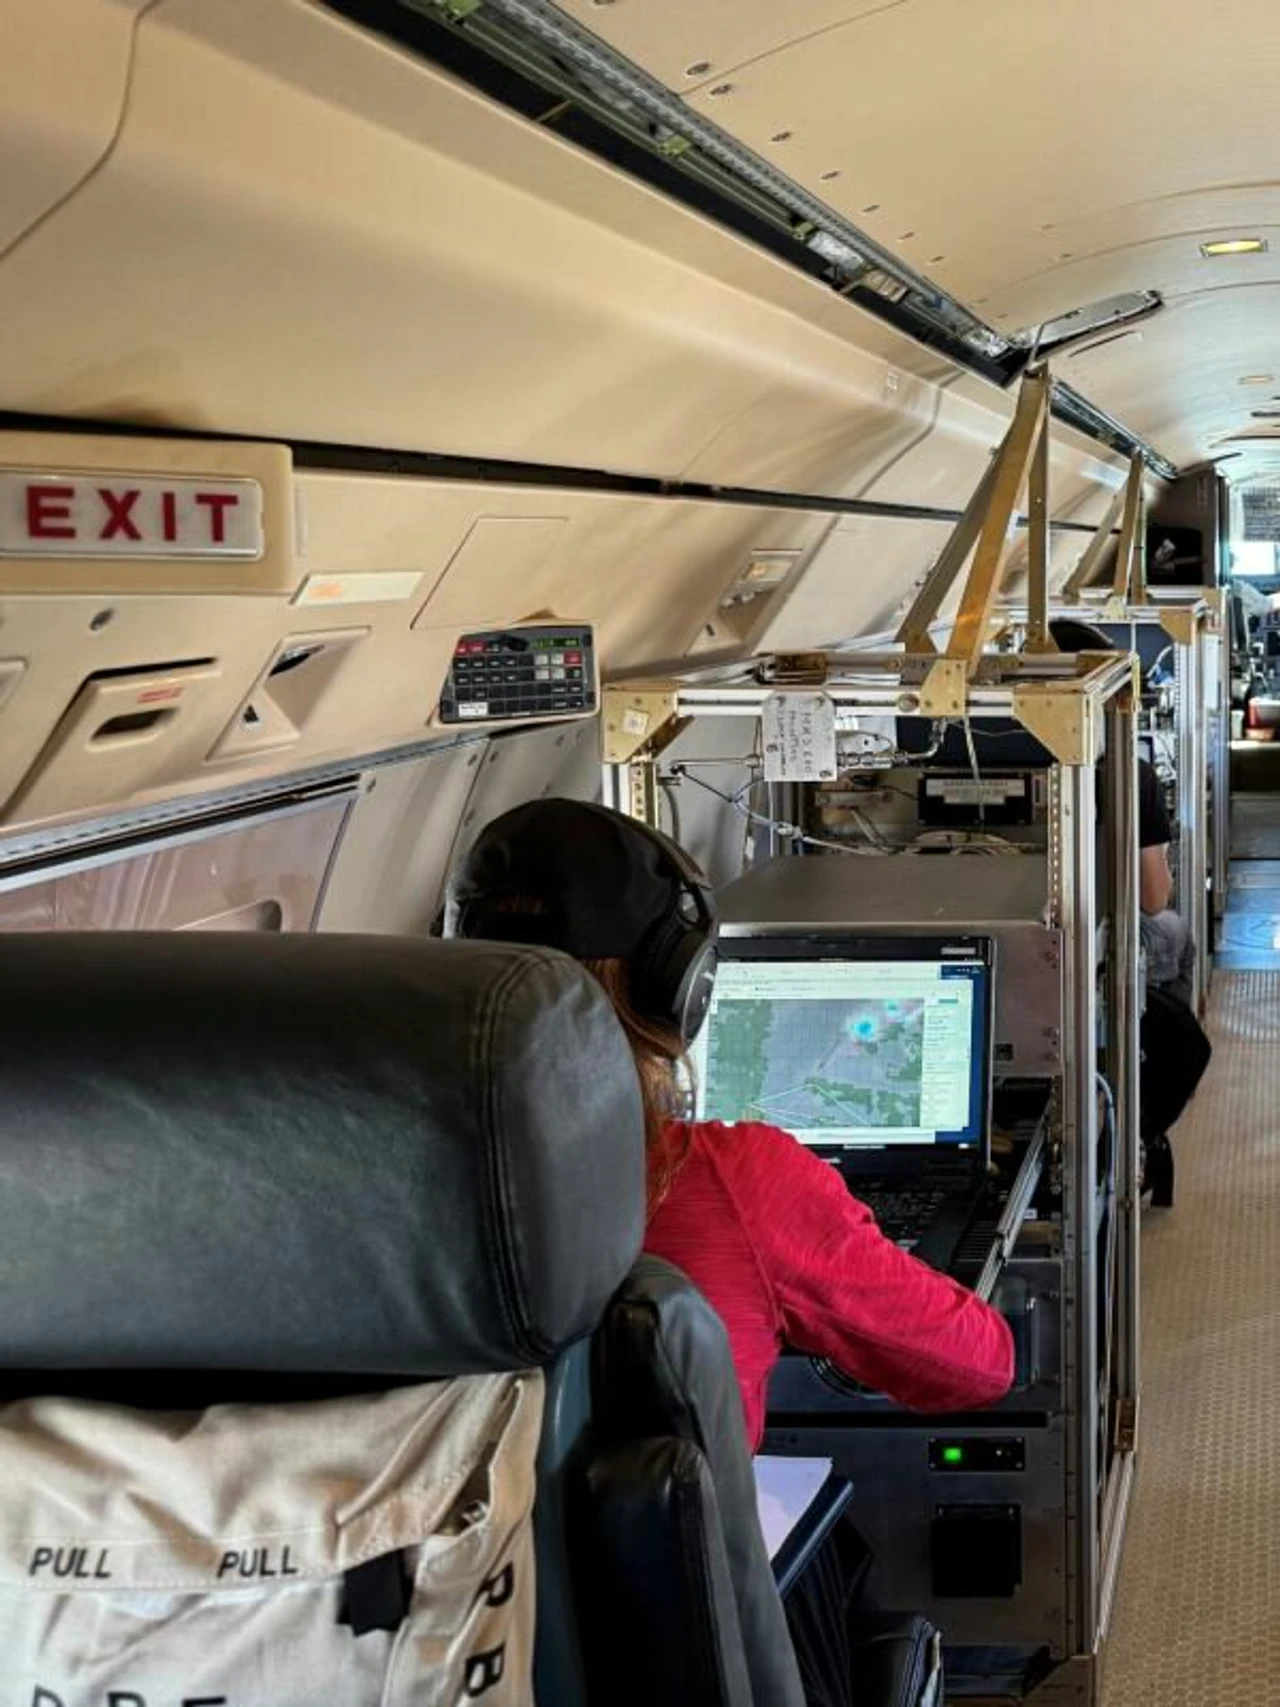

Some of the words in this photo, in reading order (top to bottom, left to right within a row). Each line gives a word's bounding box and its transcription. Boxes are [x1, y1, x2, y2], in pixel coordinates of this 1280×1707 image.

[26, 485, 239, 543] EXIT
[28, 1547, 112, 1579] PULL
[216, 1545, 299, 1579] PULL
